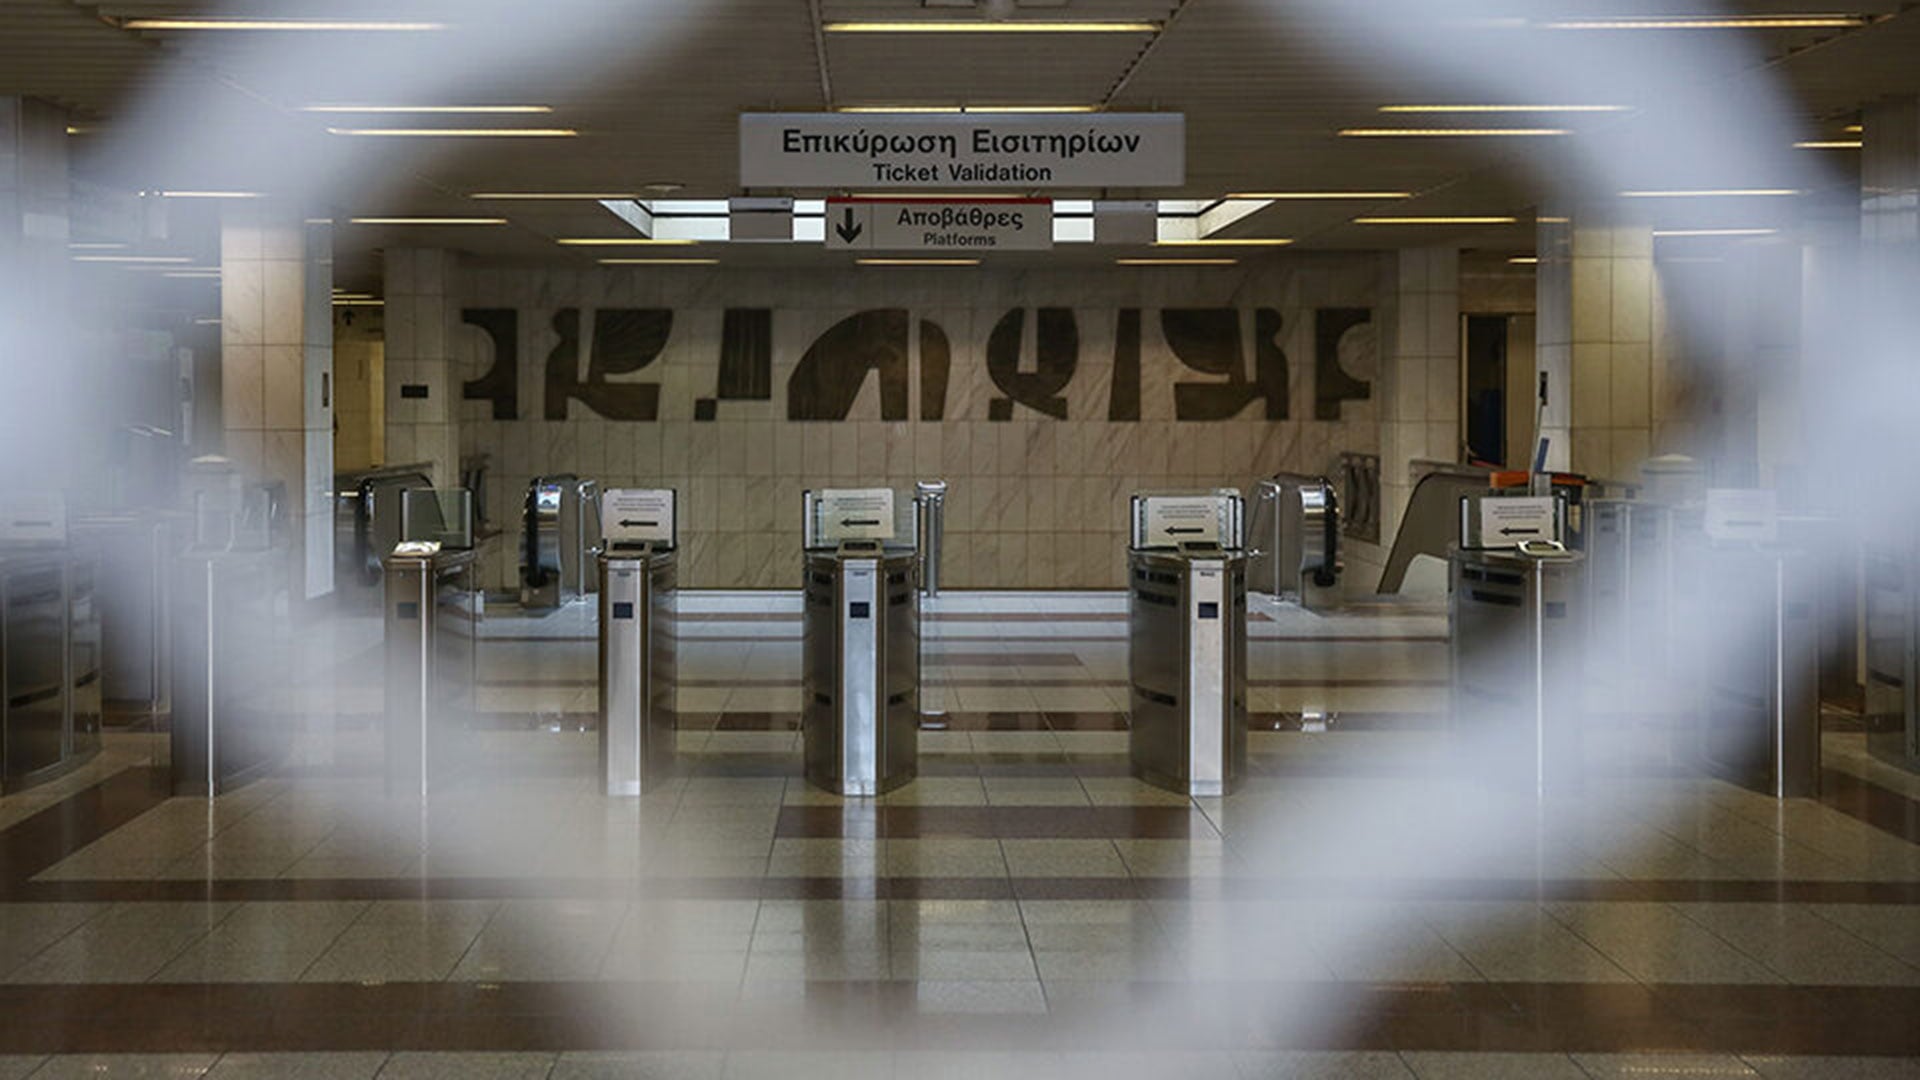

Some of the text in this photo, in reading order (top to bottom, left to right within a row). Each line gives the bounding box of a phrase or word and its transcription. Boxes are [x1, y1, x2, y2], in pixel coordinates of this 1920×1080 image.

[782, 128, 1141, 159] Επικύρωση Εισιτηρίων
[872, 163, 1052, 182] Ticket Validation
[897, 207, 1024, 231] Αποβάθρες
[923, 233, 996, 246] Platforms
